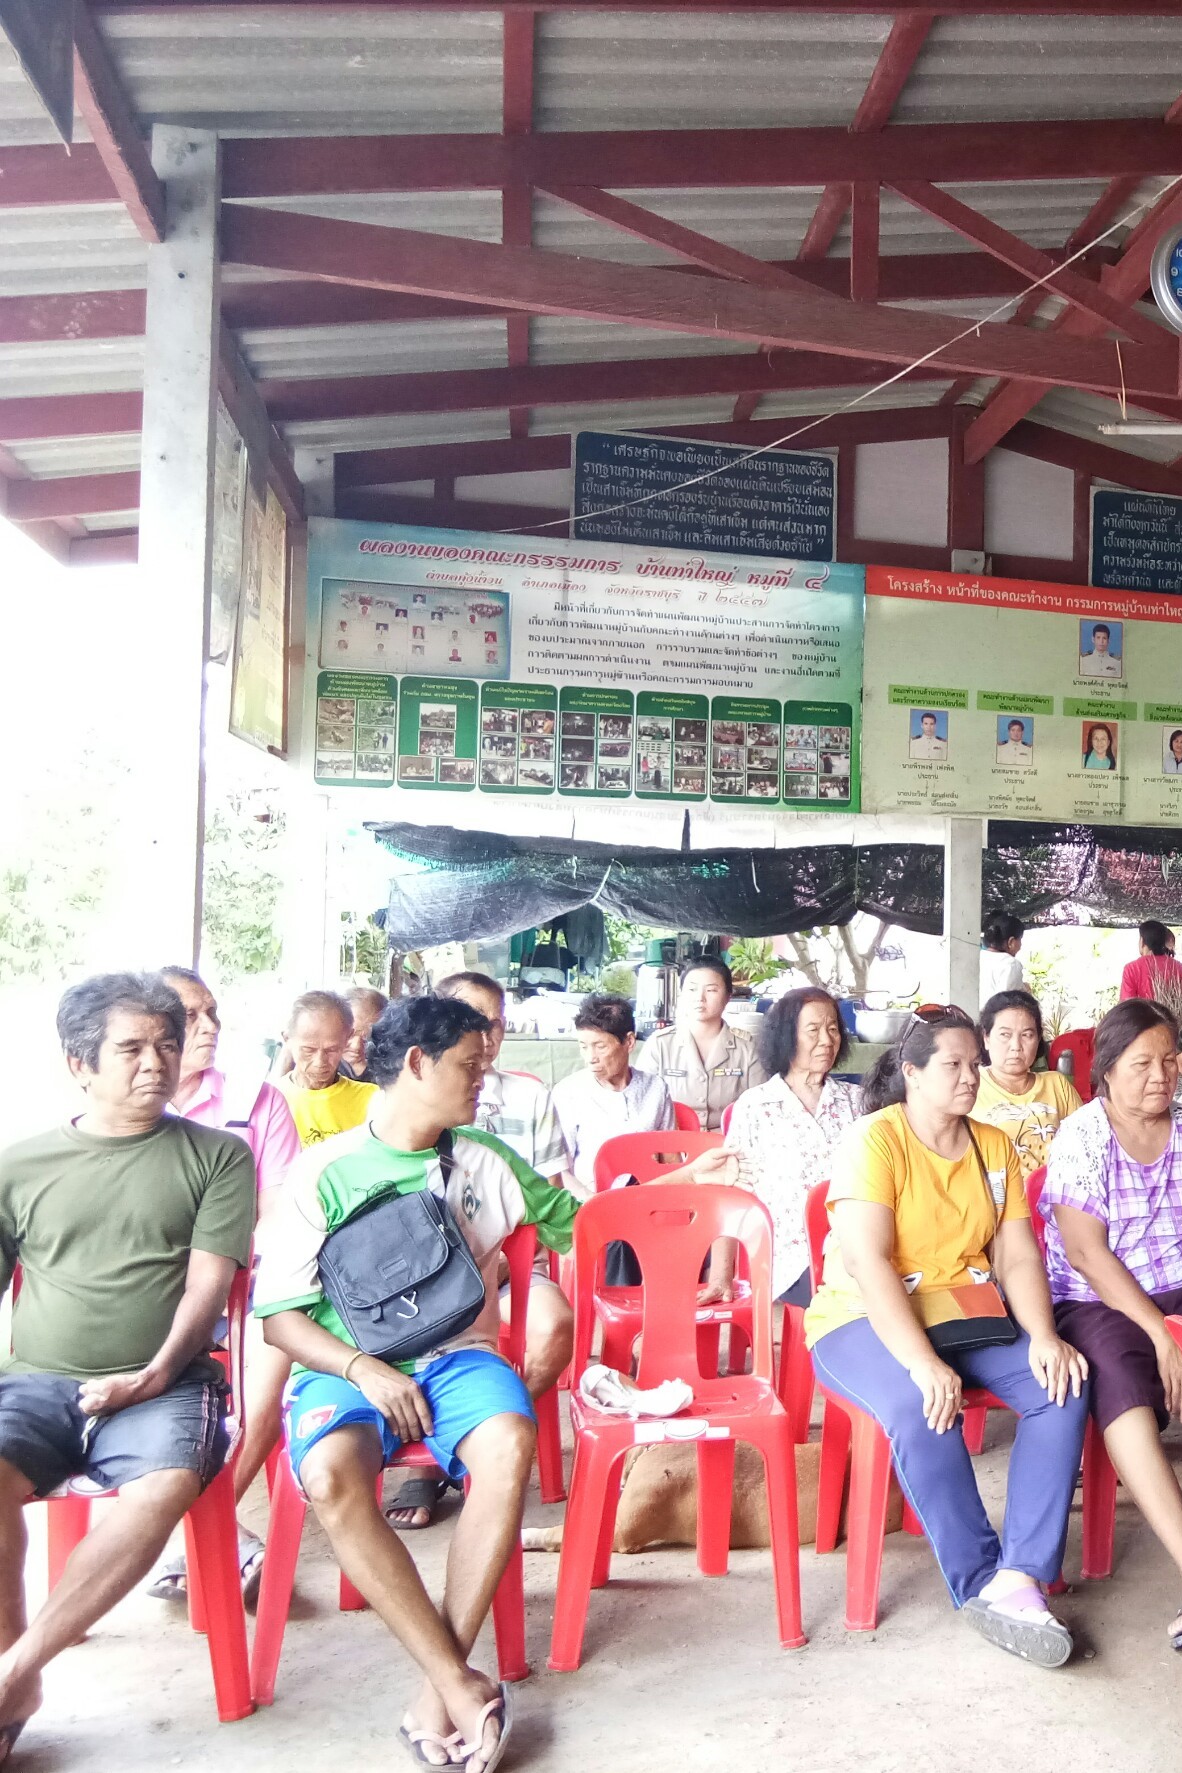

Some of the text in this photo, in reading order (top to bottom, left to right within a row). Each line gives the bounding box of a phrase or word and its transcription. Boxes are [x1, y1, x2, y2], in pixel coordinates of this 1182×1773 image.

[1171, 266, 1178, 277] 9
[804, 564, 830, 592] ๔
[887, 575, 943, 595] โครงสร้าง
[947, 581, 1062, 607] หน้าที่ของคณะทำงาน
